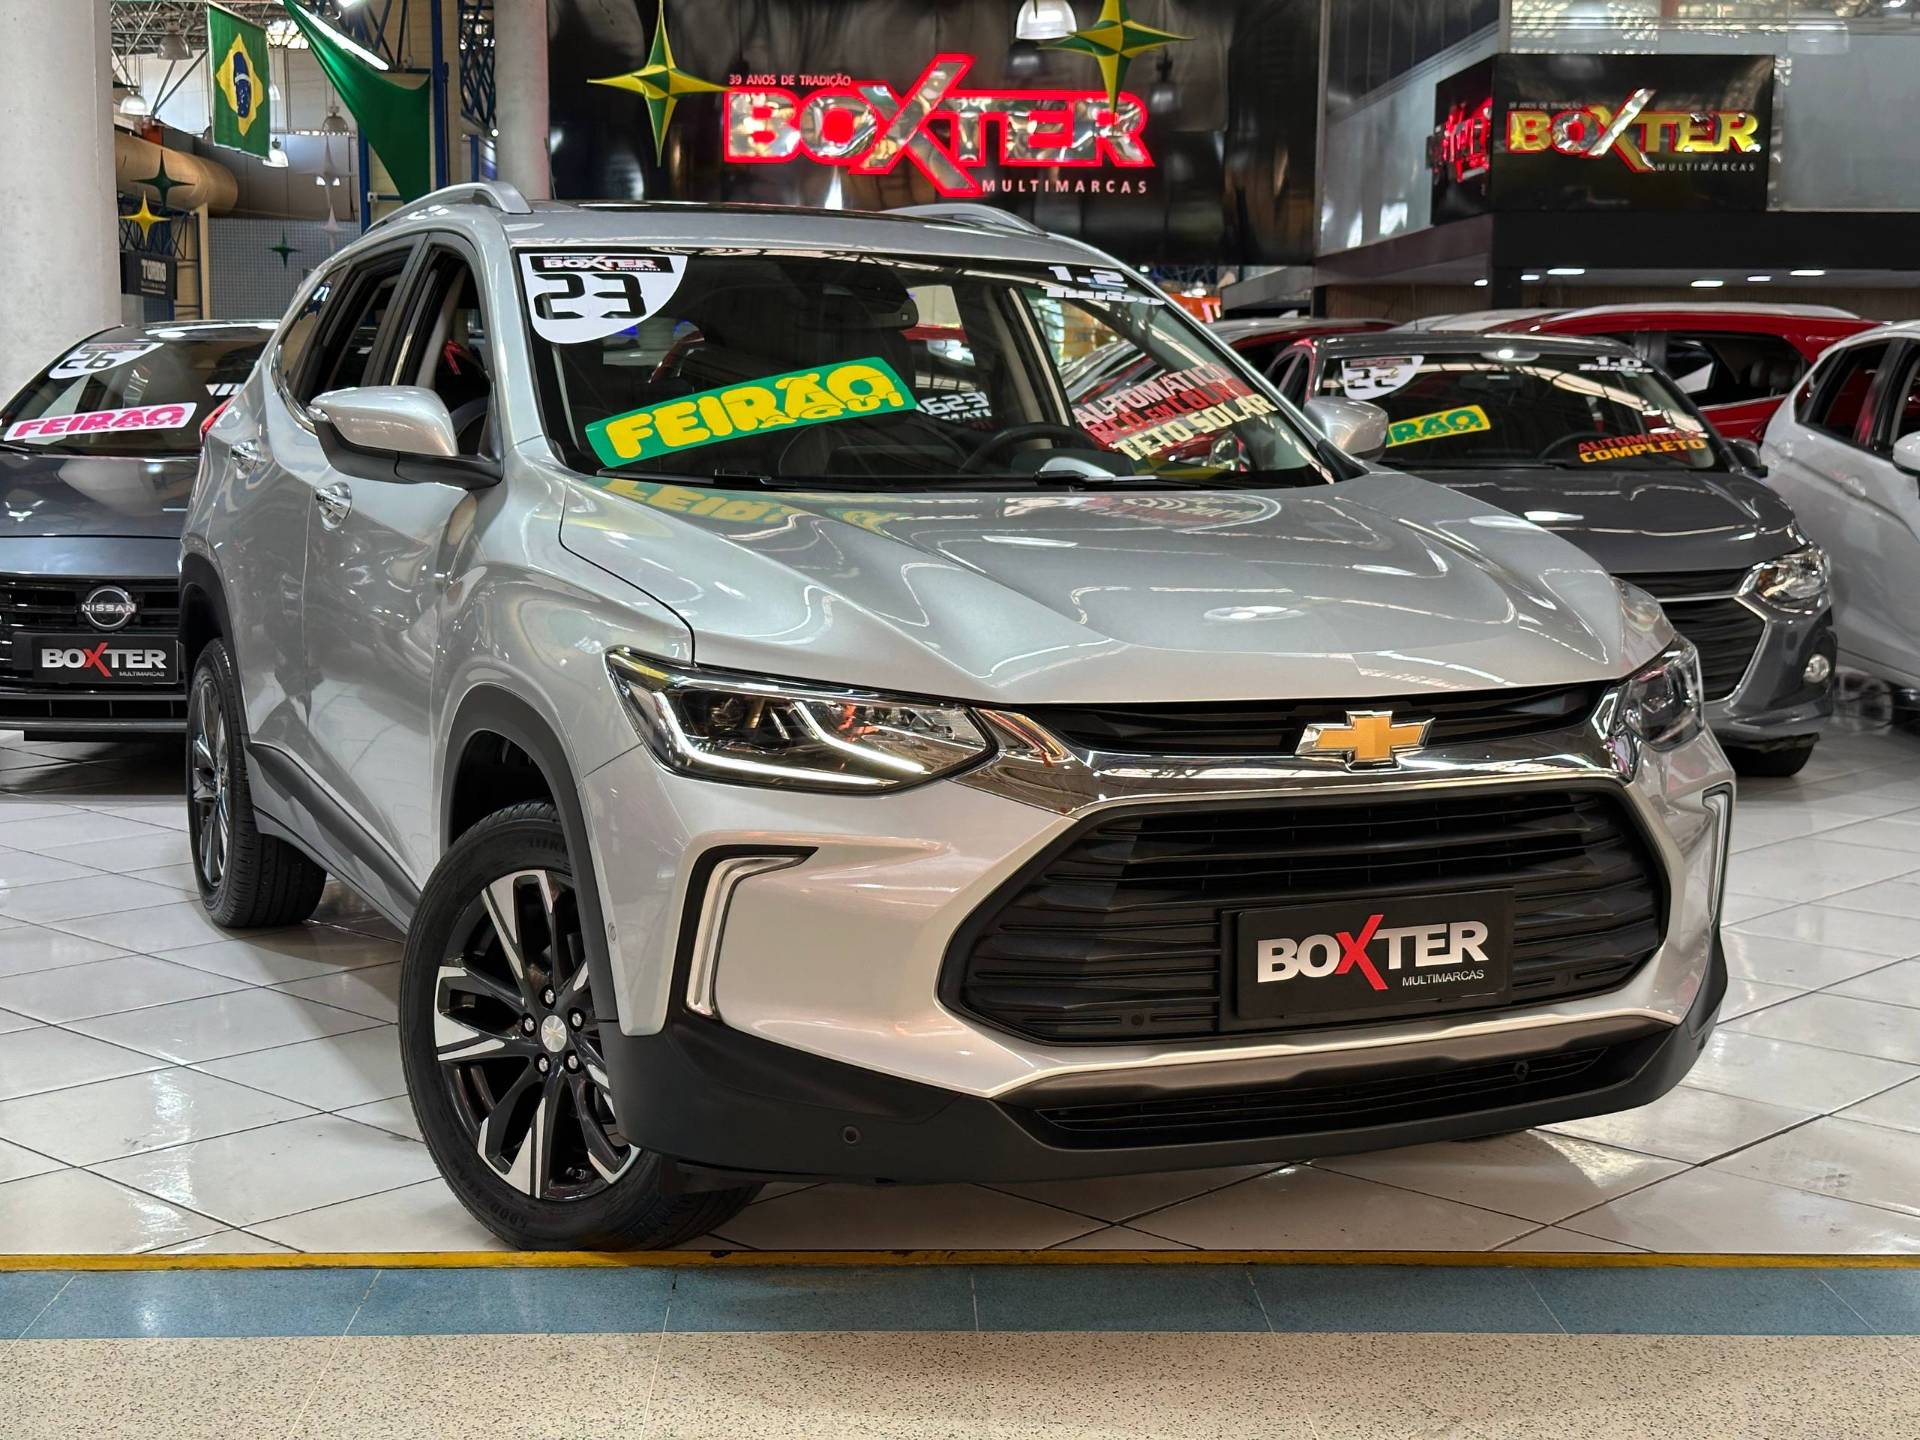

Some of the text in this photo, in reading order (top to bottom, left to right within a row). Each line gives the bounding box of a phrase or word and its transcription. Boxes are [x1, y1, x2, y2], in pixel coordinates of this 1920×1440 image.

[729, 73, 852, 88] 39 ANOS DE TRADIÇÃO
[724, 53, 1155, 198] BOXTER
[1506, 88, 1762, 172] BOXTER
[1656, 162, 1755, 172] MULTIMARCAS
[982, 179, 1147, 194] MULTIMARCAS
[543, 256, 655, 271] BOXTER
[1048, 266, 1128, 288] 1.2
[533, 273, 647, 320] 23
[58, 350, 123, 369] 26
[1596, 356, 1643, 368] 1.0
[1346, 366, 1401, 390] 22
[1072, 362, 1233, 430] AUTOMÁTICO
[13, 405, 186, 437] FEIRÃO
[605, 365, 902, 458] FEIRÃO
[1144, 402, 1179, 425] EM
[1109, 393, 1279, 461] TETO SOLAR
[1579, 438, 1708, 464] COMPLETO
[81, 603, 136, 613] NISSAN
[41, 641, 168, 678] BOXTER
[1257, 913, 1489, 990] BOXTER
[1402, 969, 1485, 987] MULTIMARCAS
